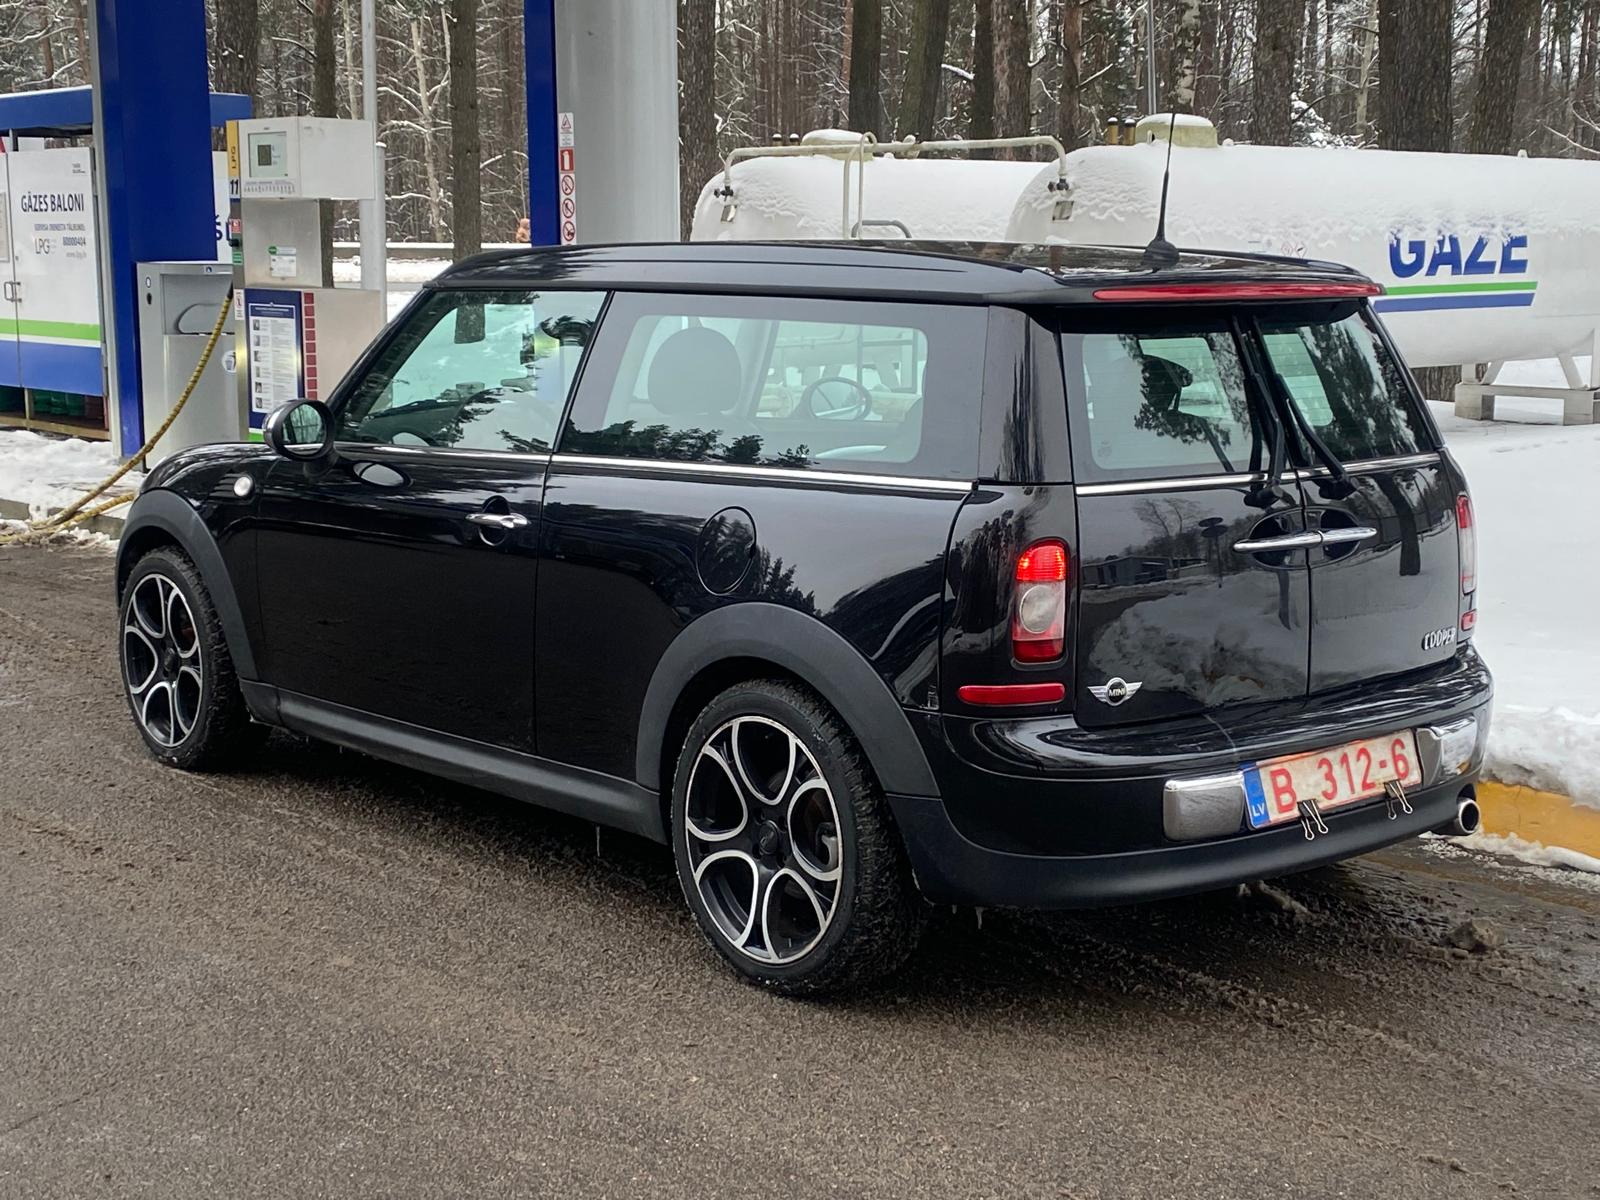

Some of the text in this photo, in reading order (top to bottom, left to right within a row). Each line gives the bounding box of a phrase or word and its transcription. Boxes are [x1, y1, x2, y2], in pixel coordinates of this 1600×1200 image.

[230, 179, 239, 195] 11
[21, 191, 84, 212] GĀZES BALONI
[35, 238, 50, 254] LPG
[1109, 687, 1126, 697] MINI
[1270, 738, 1410, 813] B 312-6
[1252, 804, 1266, 817] LV
